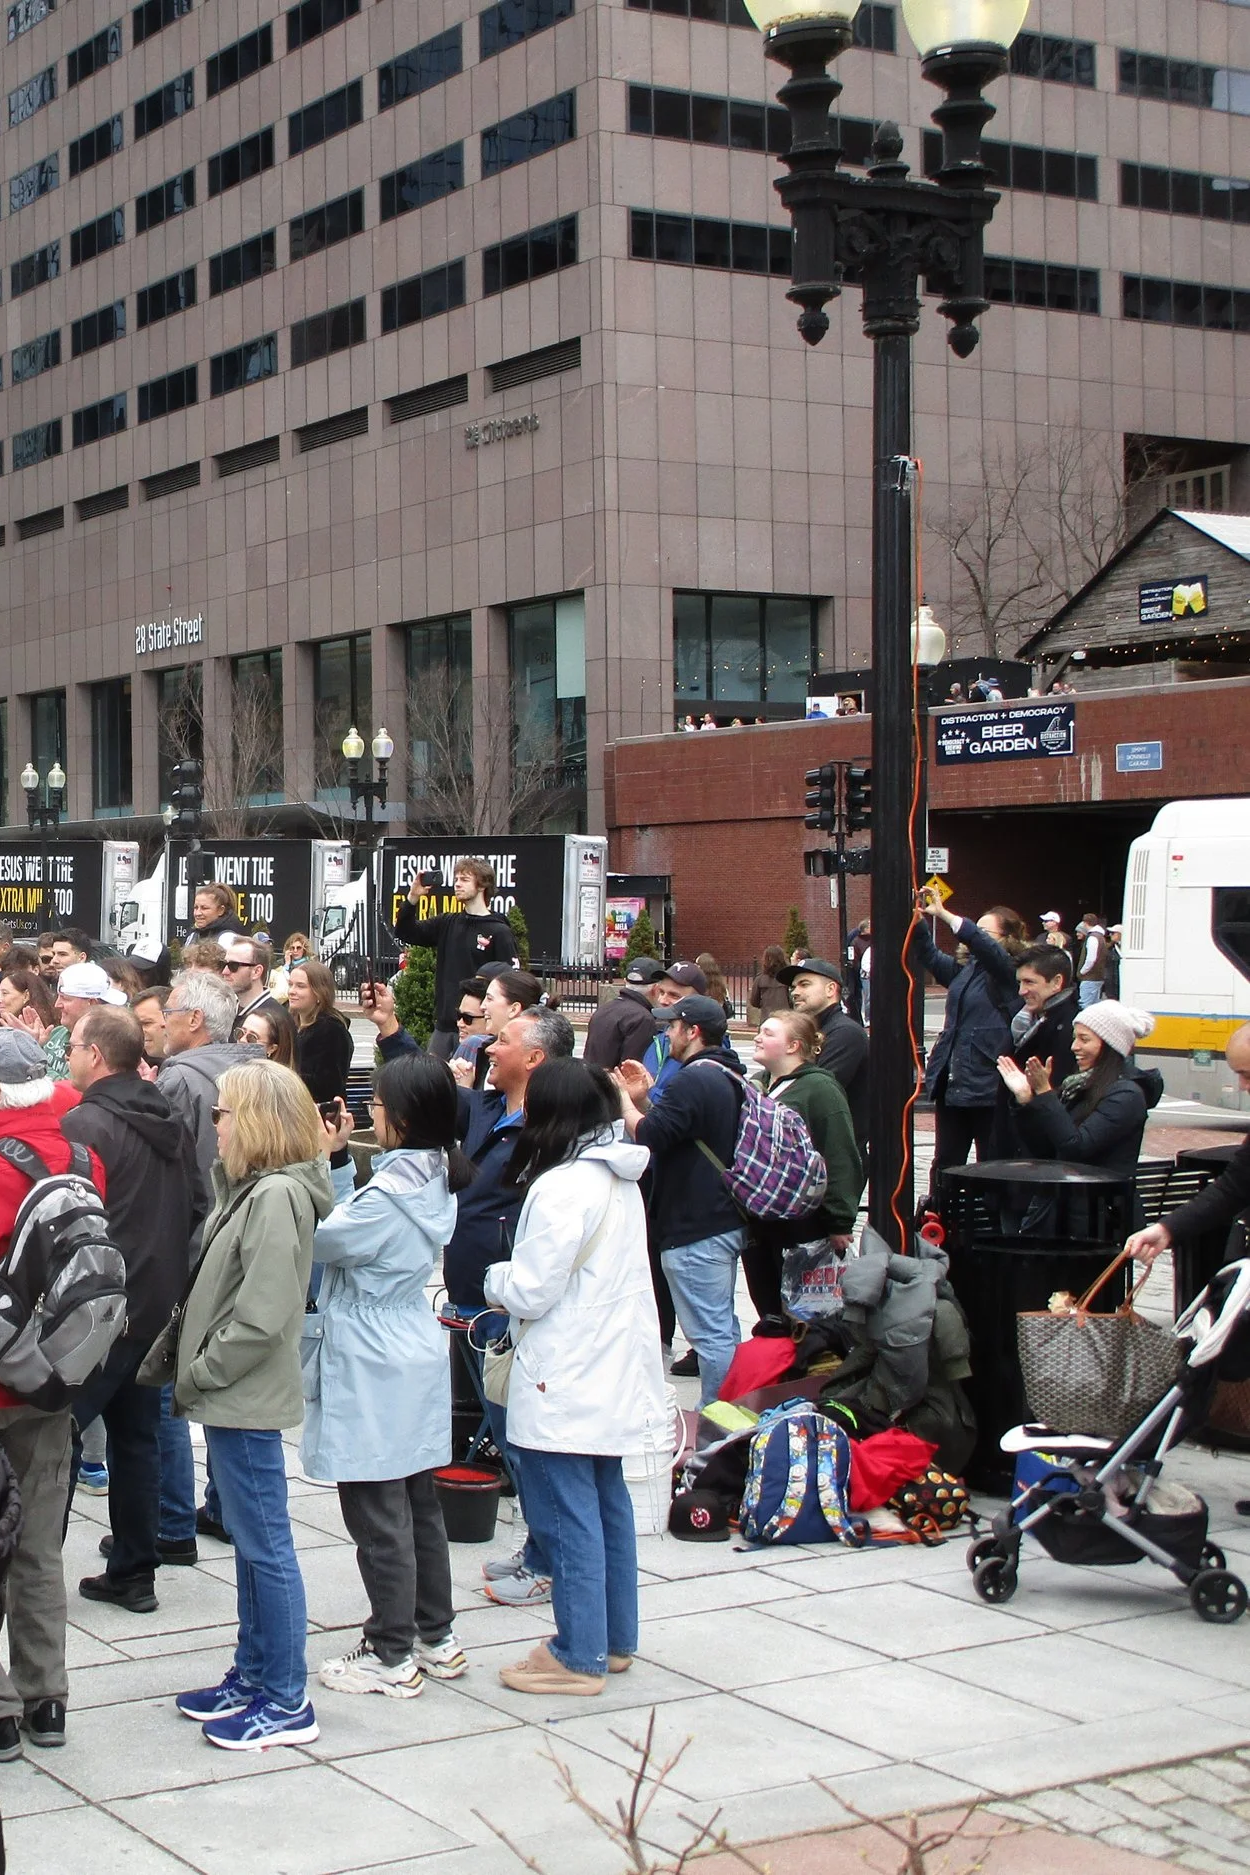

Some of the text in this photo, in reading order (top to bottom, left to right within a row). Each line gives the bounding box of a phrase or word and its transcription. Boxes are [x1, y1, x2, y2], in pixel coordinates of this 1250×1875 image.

[482, 413, 539, 444] Citizens
[1140, 605, 1161, 614] BEER
[1140, 611, 1173, 620] GARDEN
[135, 612, 203, 654] 28 State Street
[940, 713, 999, 725] DISTRACTION
[1008, 706, 1067, 719] DEMOCRACY
[969, 737, 1037, 754] GARDEN
[981, 723, 1024, 739] BEER
[25, 855, 54, 882] WET
[56, 856, 74, 883] THE
[214, 856, 250, 886] WENT
[251, 856, 274, 887] THE
[26, 887, 52, 918] MI,
[54, 888, 73, 916] TOO
[250, 893, 274, 924] TOO
[392, 892, 437, 927] ERA
